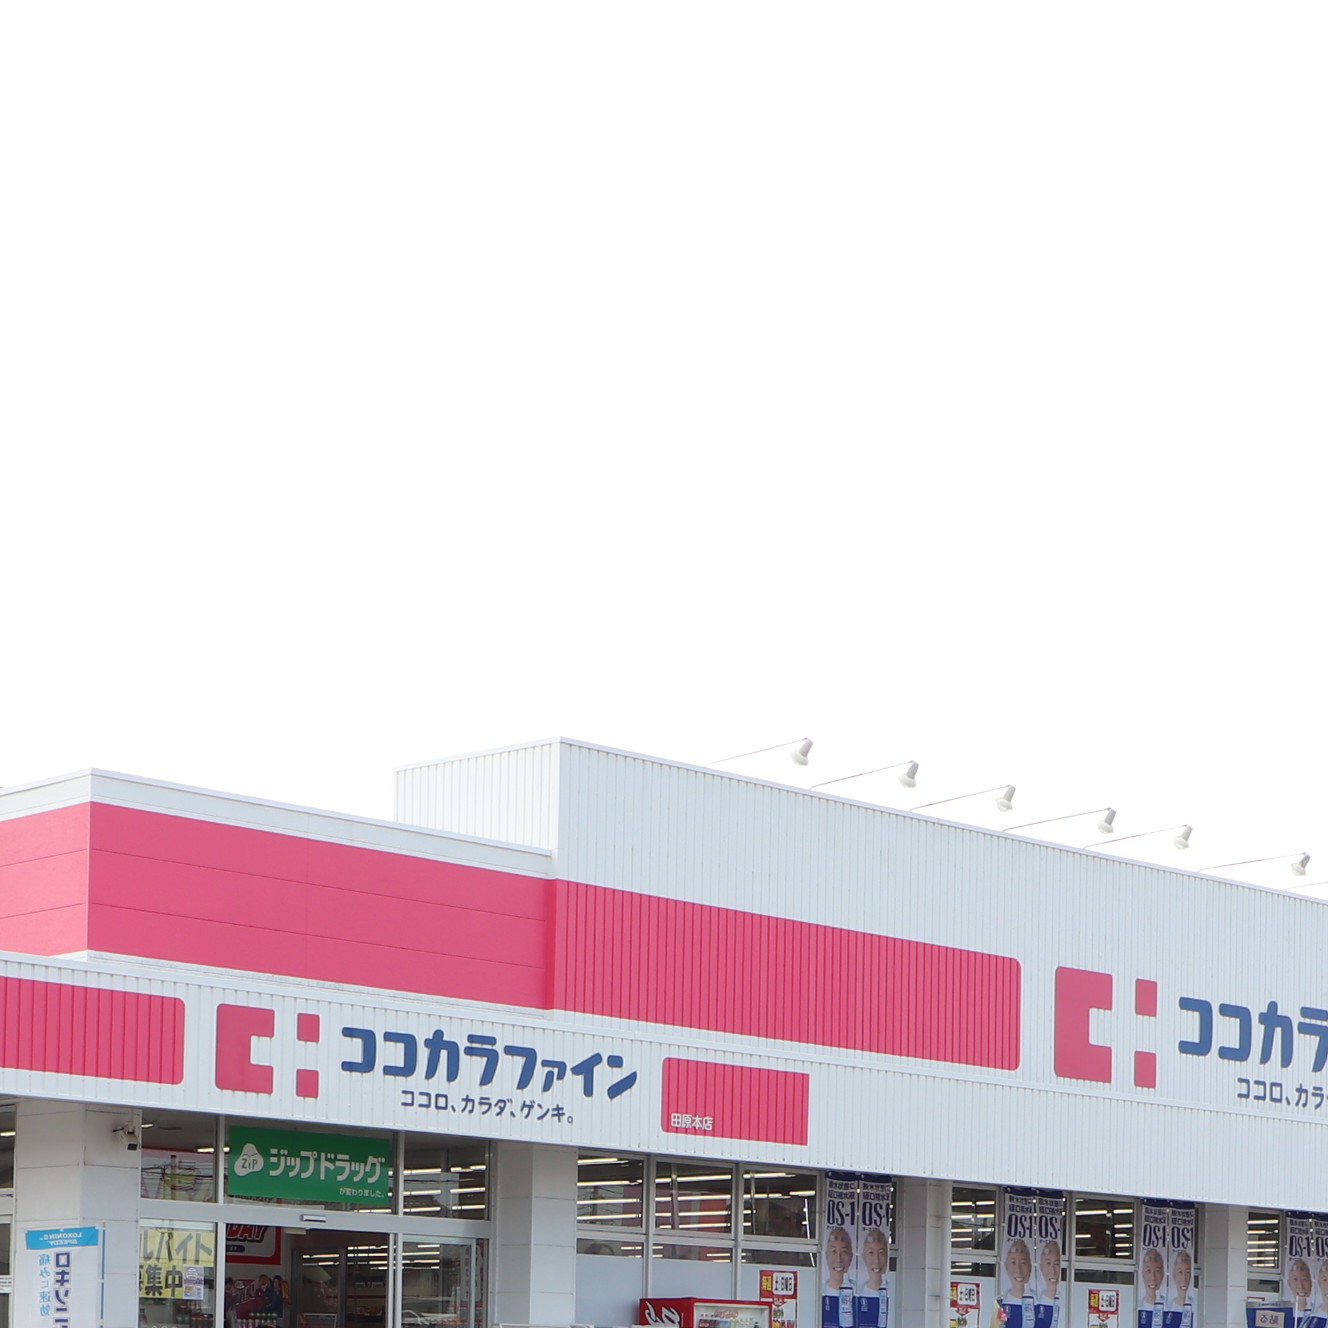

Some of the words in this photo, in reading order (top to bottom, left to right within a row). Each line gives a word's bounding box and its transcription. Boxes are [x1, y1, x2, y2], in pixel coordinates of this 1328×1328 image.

[341, 1026, 638, 1100] ココカラファイン
[401, 1089, 574, 1125] ココロ、カラダ、ゲンキ。
[671, 1112, 713, 1131] 田原本店
[269, 1148, 385, 1184] ジップドラッグ
[827, 1200, 855, 1226] OS-1
[1289, 1235, 1311, 1257] OS-1
[139, 1264, 183, 1298] 集中
